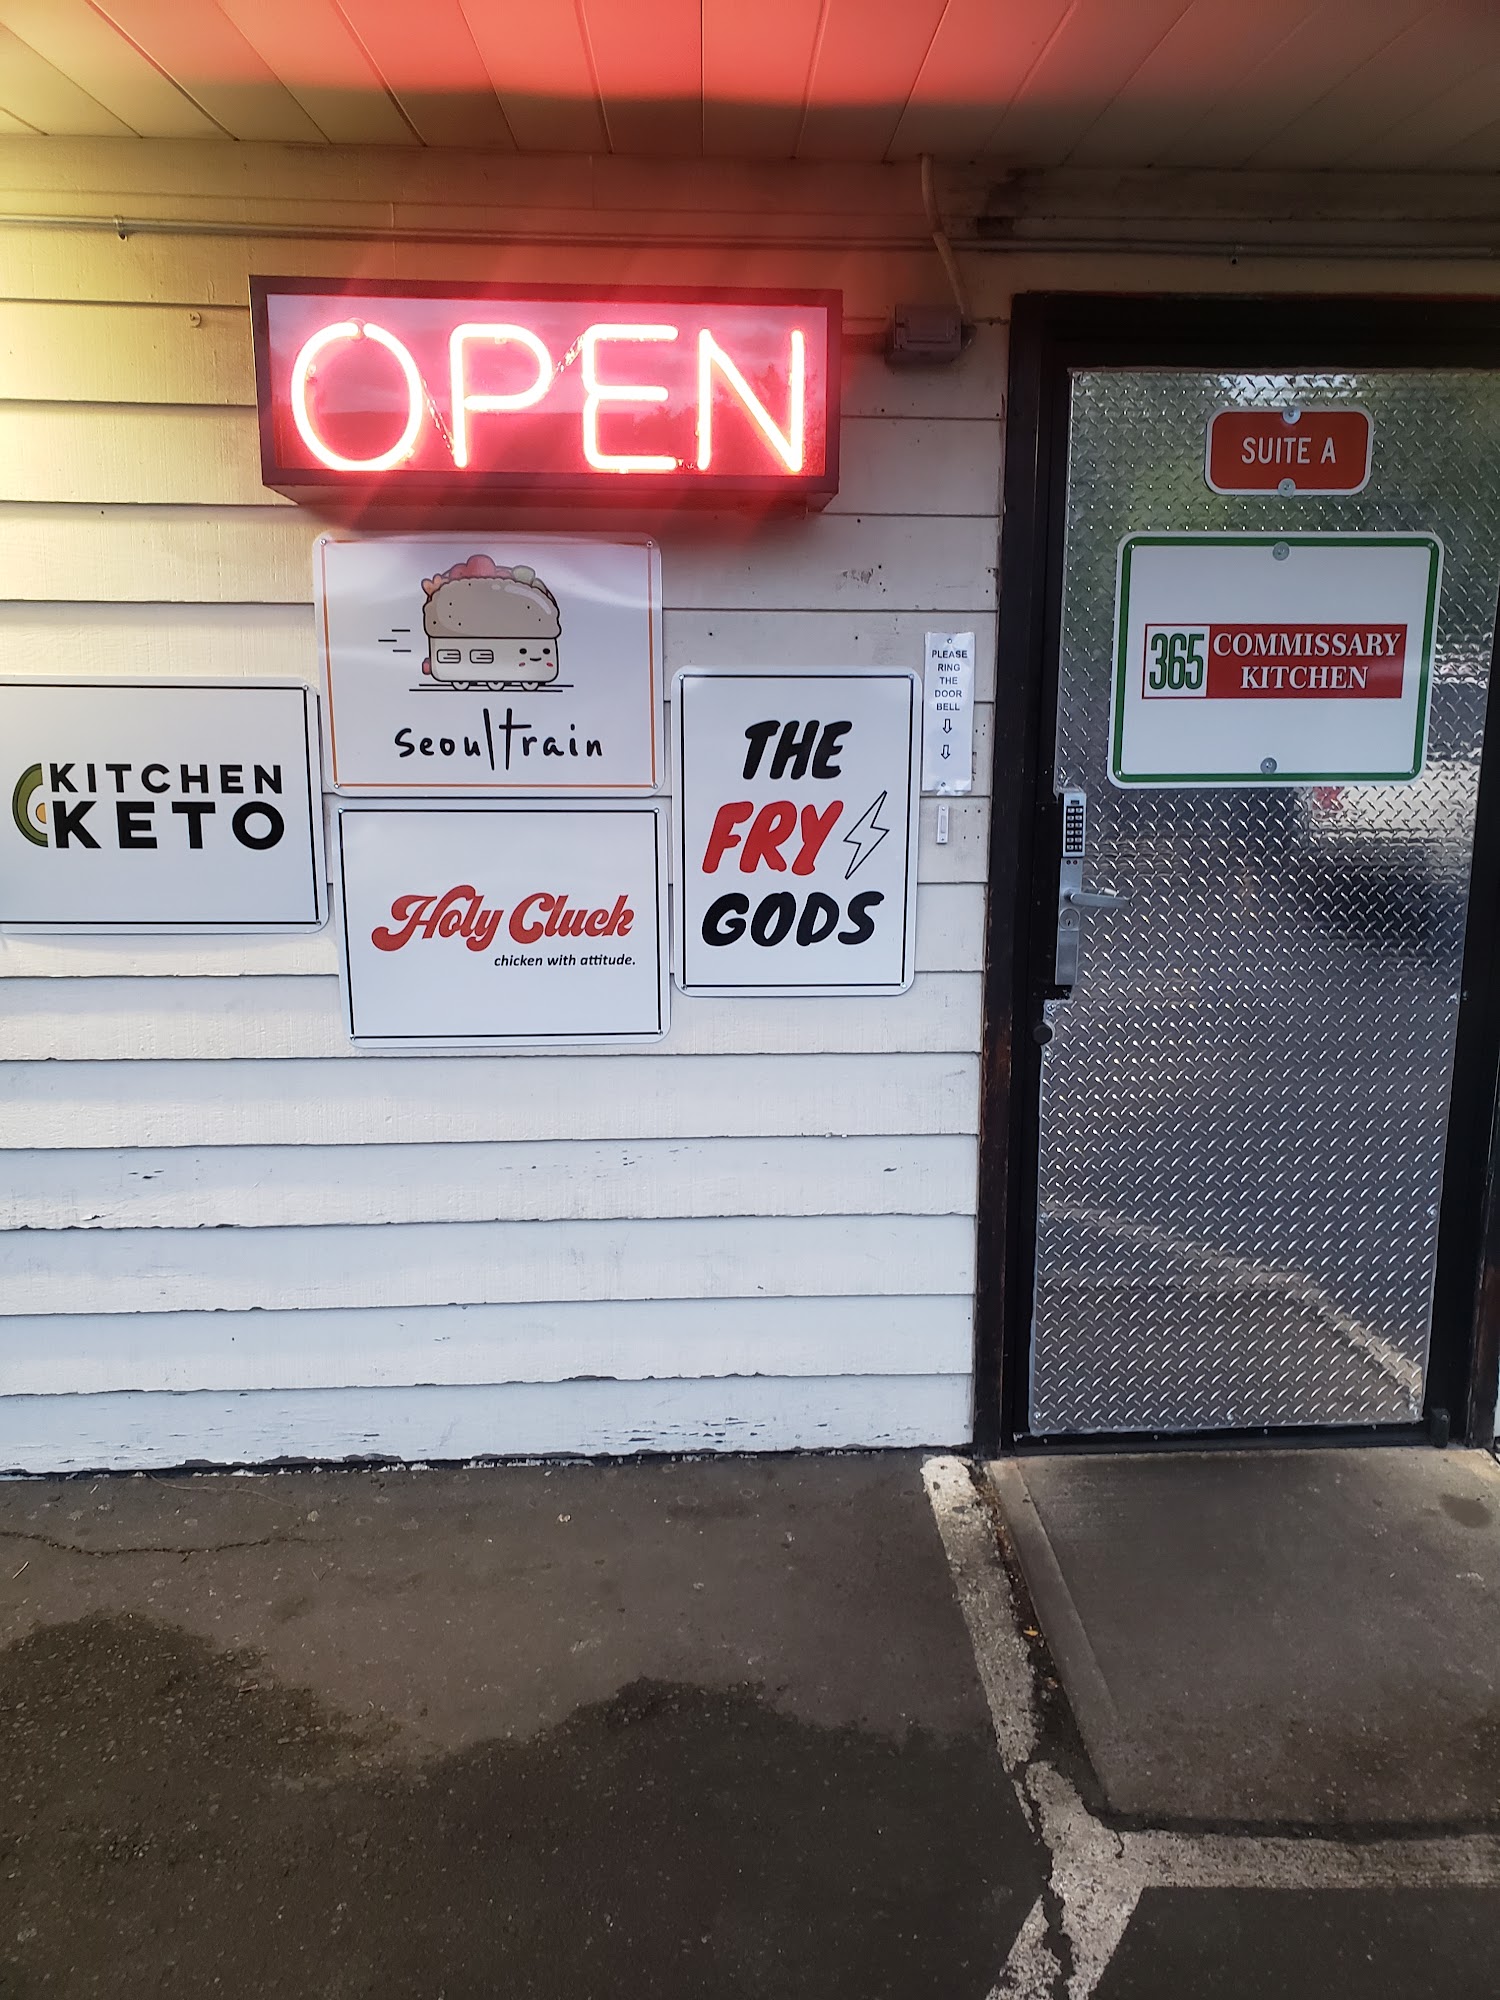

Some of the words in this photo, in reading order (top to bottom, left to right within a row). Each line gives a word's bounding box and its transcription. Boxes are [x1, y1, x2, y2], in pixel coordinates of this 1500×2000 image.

[291, 319, 806, 473] OPEN
[1241, 437, 1312, 465] SUITE
[1320, 438, 1337, 464] A
[931, 650, 968, 659] PLEASE
[1213, 632, 1401, 658] COMMISSARY
[937, 663, 960, 672] RING
[1148, 632, 1205, 691] 365
[939, 676, 958, 685] THE
[1240, 665, 1369, 690] KITCHEN
[934, 689, 962, 698] DOOR
[936, 702, 960, 711] BELL
[743, 719, 852, 780] THE
[49, 763, 283, 794] KITCHEN
[52, 800, 285, 850] KETO
[702, 799, 844, 876] FRY
[371, 884, 504, 952] Holy
[508, 892, 635, 944] Cluck
[700, 890, 885, 947] GODS
[494, 954, 543, 966] chicken
[547, 953, 576, 966] with
[580, 953, 636, 966] attitude.
